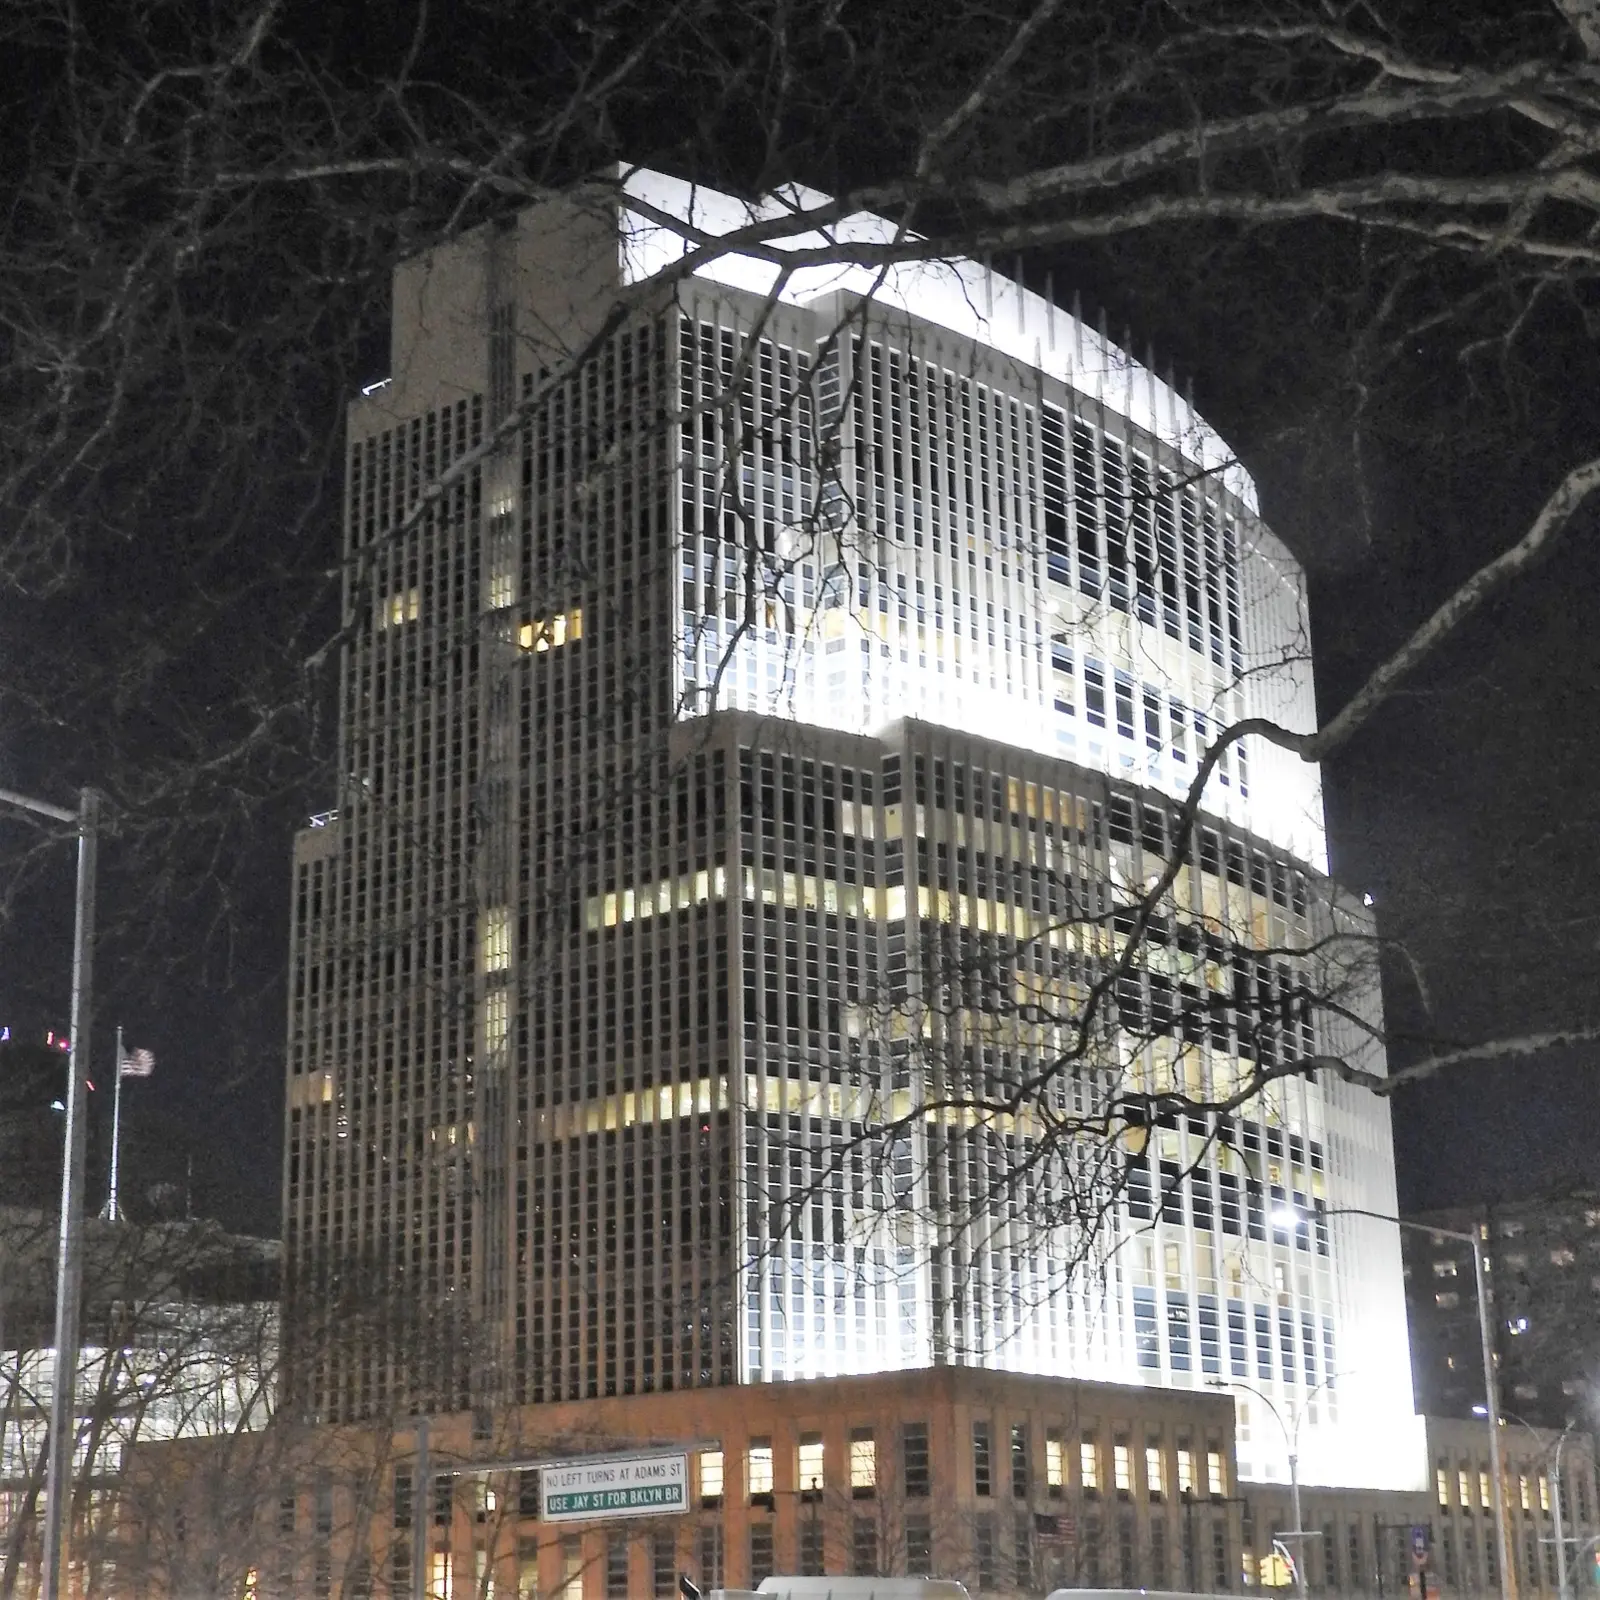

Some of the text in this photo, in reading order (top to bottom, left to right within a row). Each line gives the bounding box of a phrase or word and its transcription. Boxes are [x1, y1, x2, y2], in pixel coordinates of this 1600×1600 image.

[546, 1463, 680, 1488] NO LEFT TURNS AT ADAMS ST
[550, 1487, 680, 1511] USE JAY ST FOR BKLYN BR
